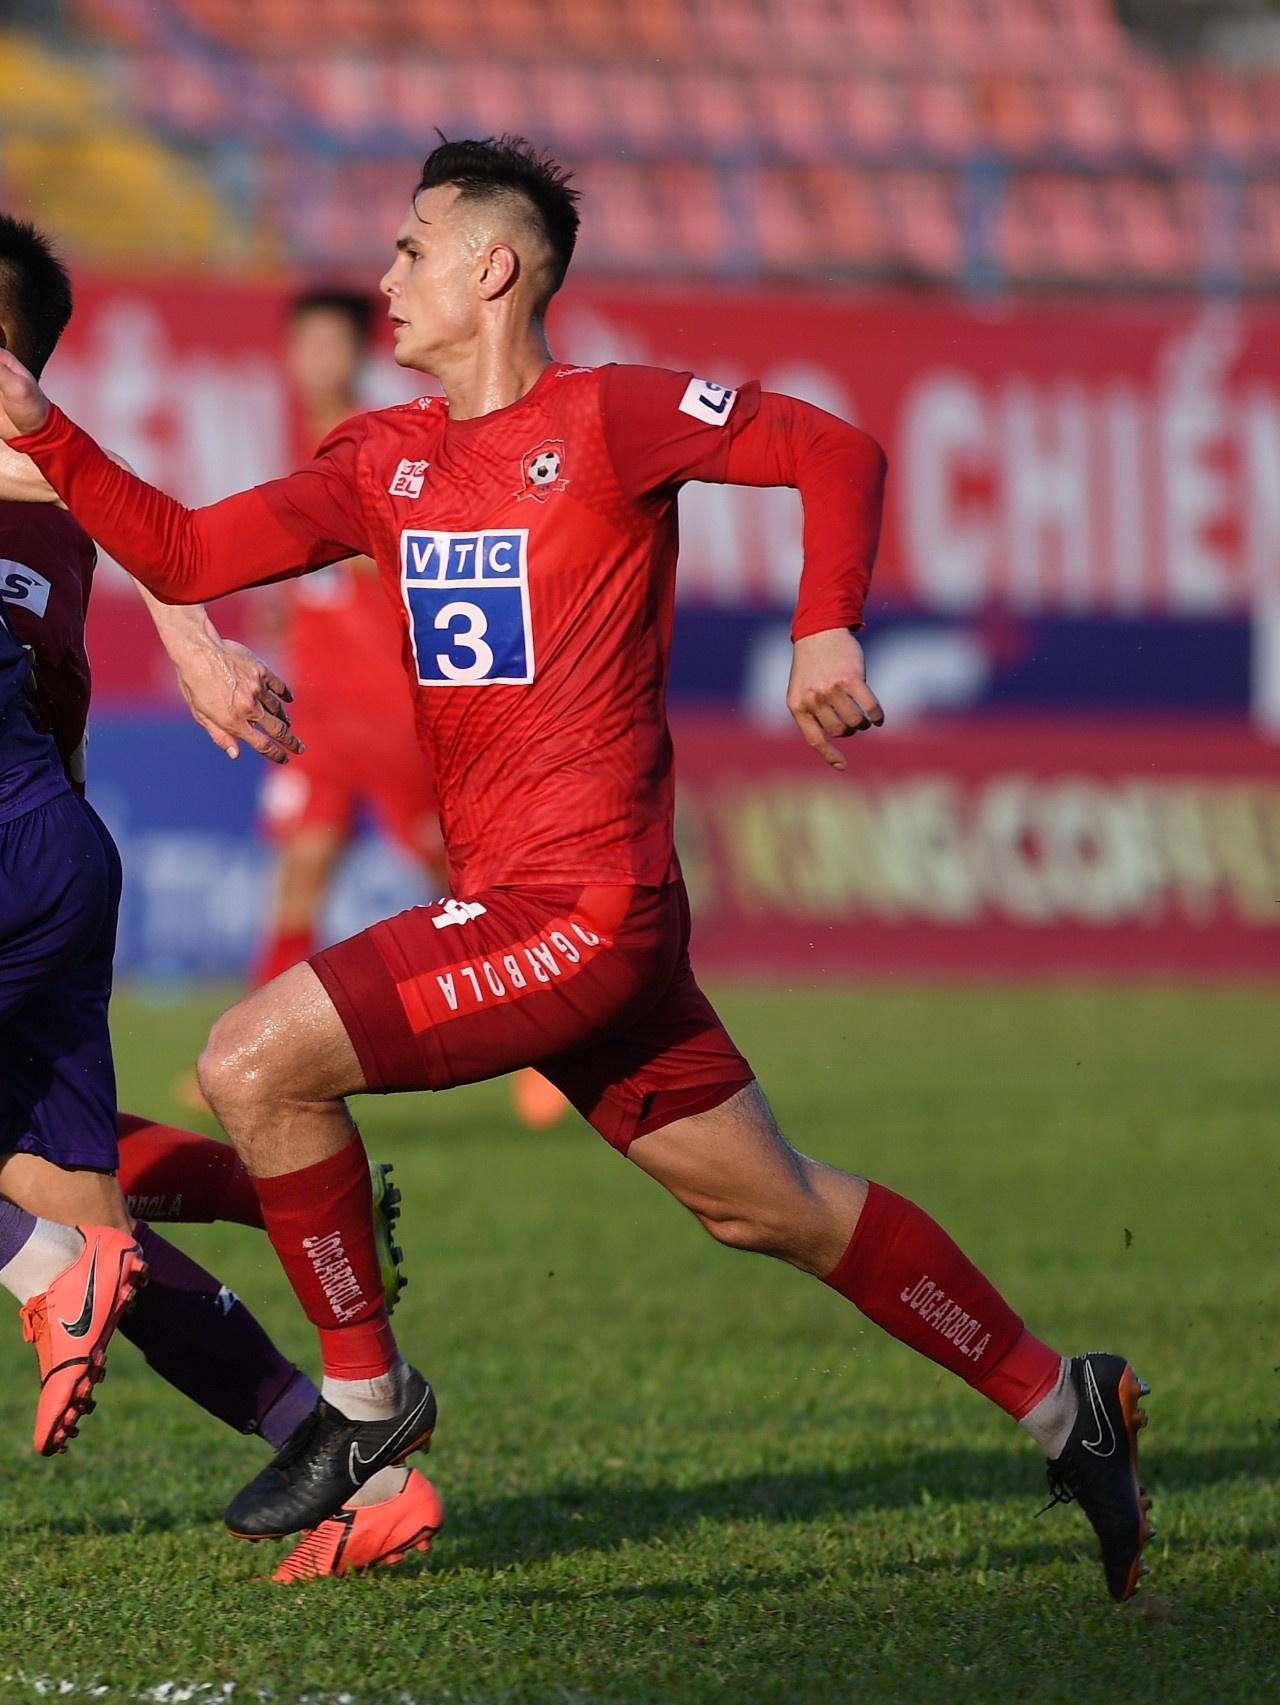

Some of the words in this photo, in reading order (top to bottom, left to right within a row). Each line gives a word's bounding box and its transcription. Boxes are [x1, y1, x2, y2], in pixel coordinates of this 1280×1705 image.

[411, 541, 513, 573] VTC
[434, 601, 494, 680] 3
[435, 921, 604, 1011] OGARBOLA
[901, 1275, 992, 1362] JOGARBOLA
